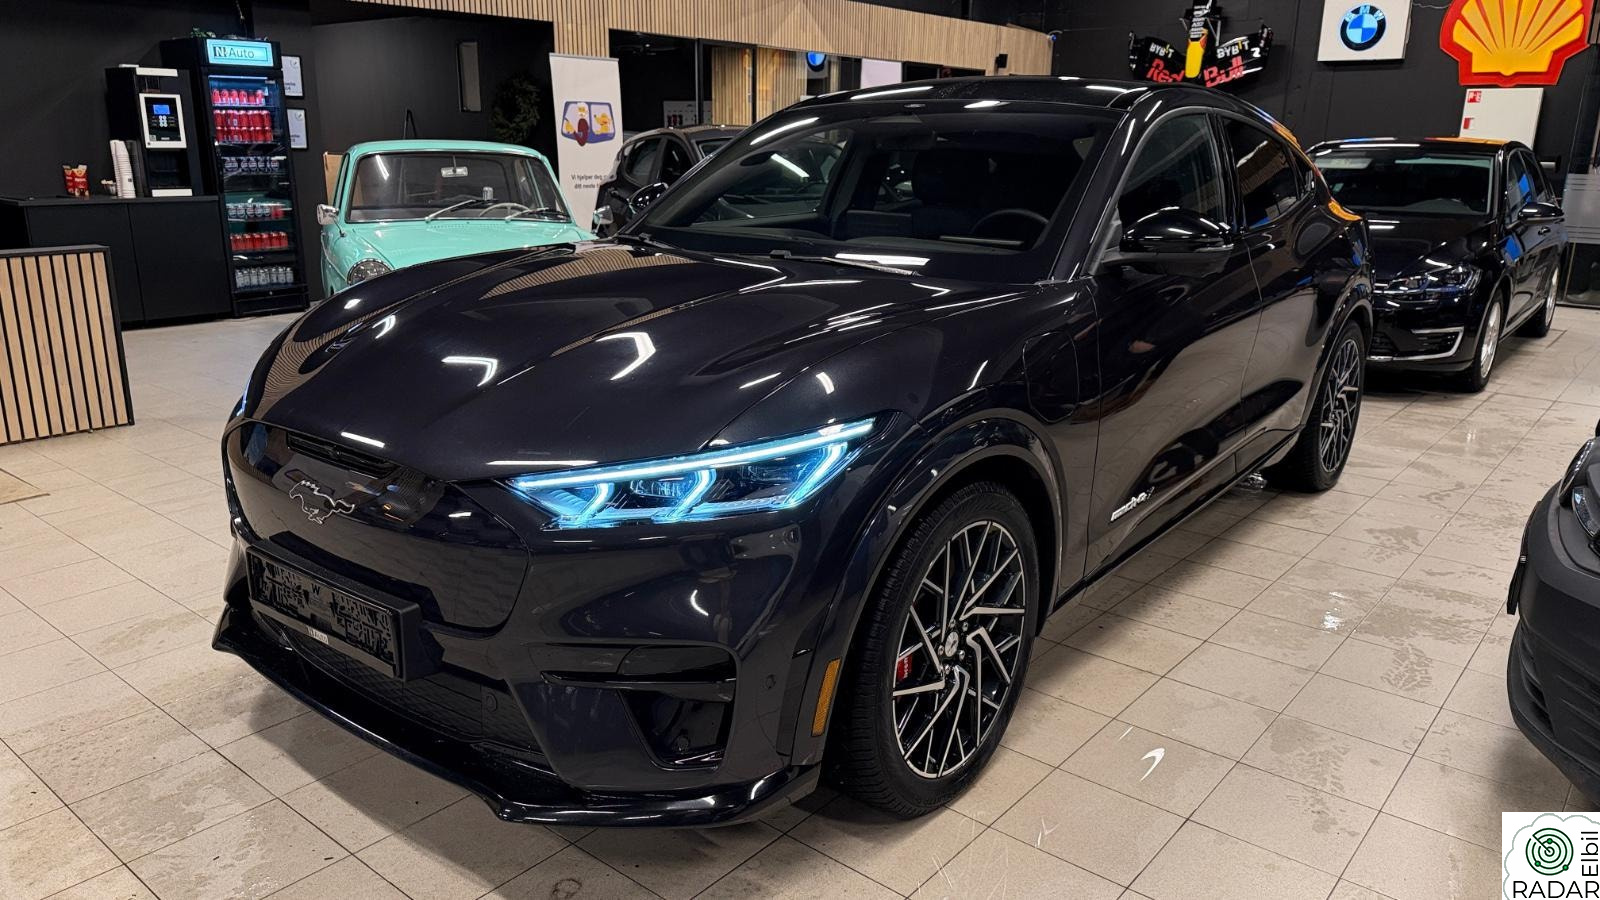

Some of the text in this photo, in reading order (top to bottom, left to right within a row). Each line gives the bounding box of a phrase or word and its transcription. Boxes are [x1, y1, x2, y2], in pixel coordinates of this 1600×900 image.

[229, 47, 255, 59] Auto
[1217, 40, 1249, 58] BYBIT
[1146, 56, 1244, 88] Red Bull
